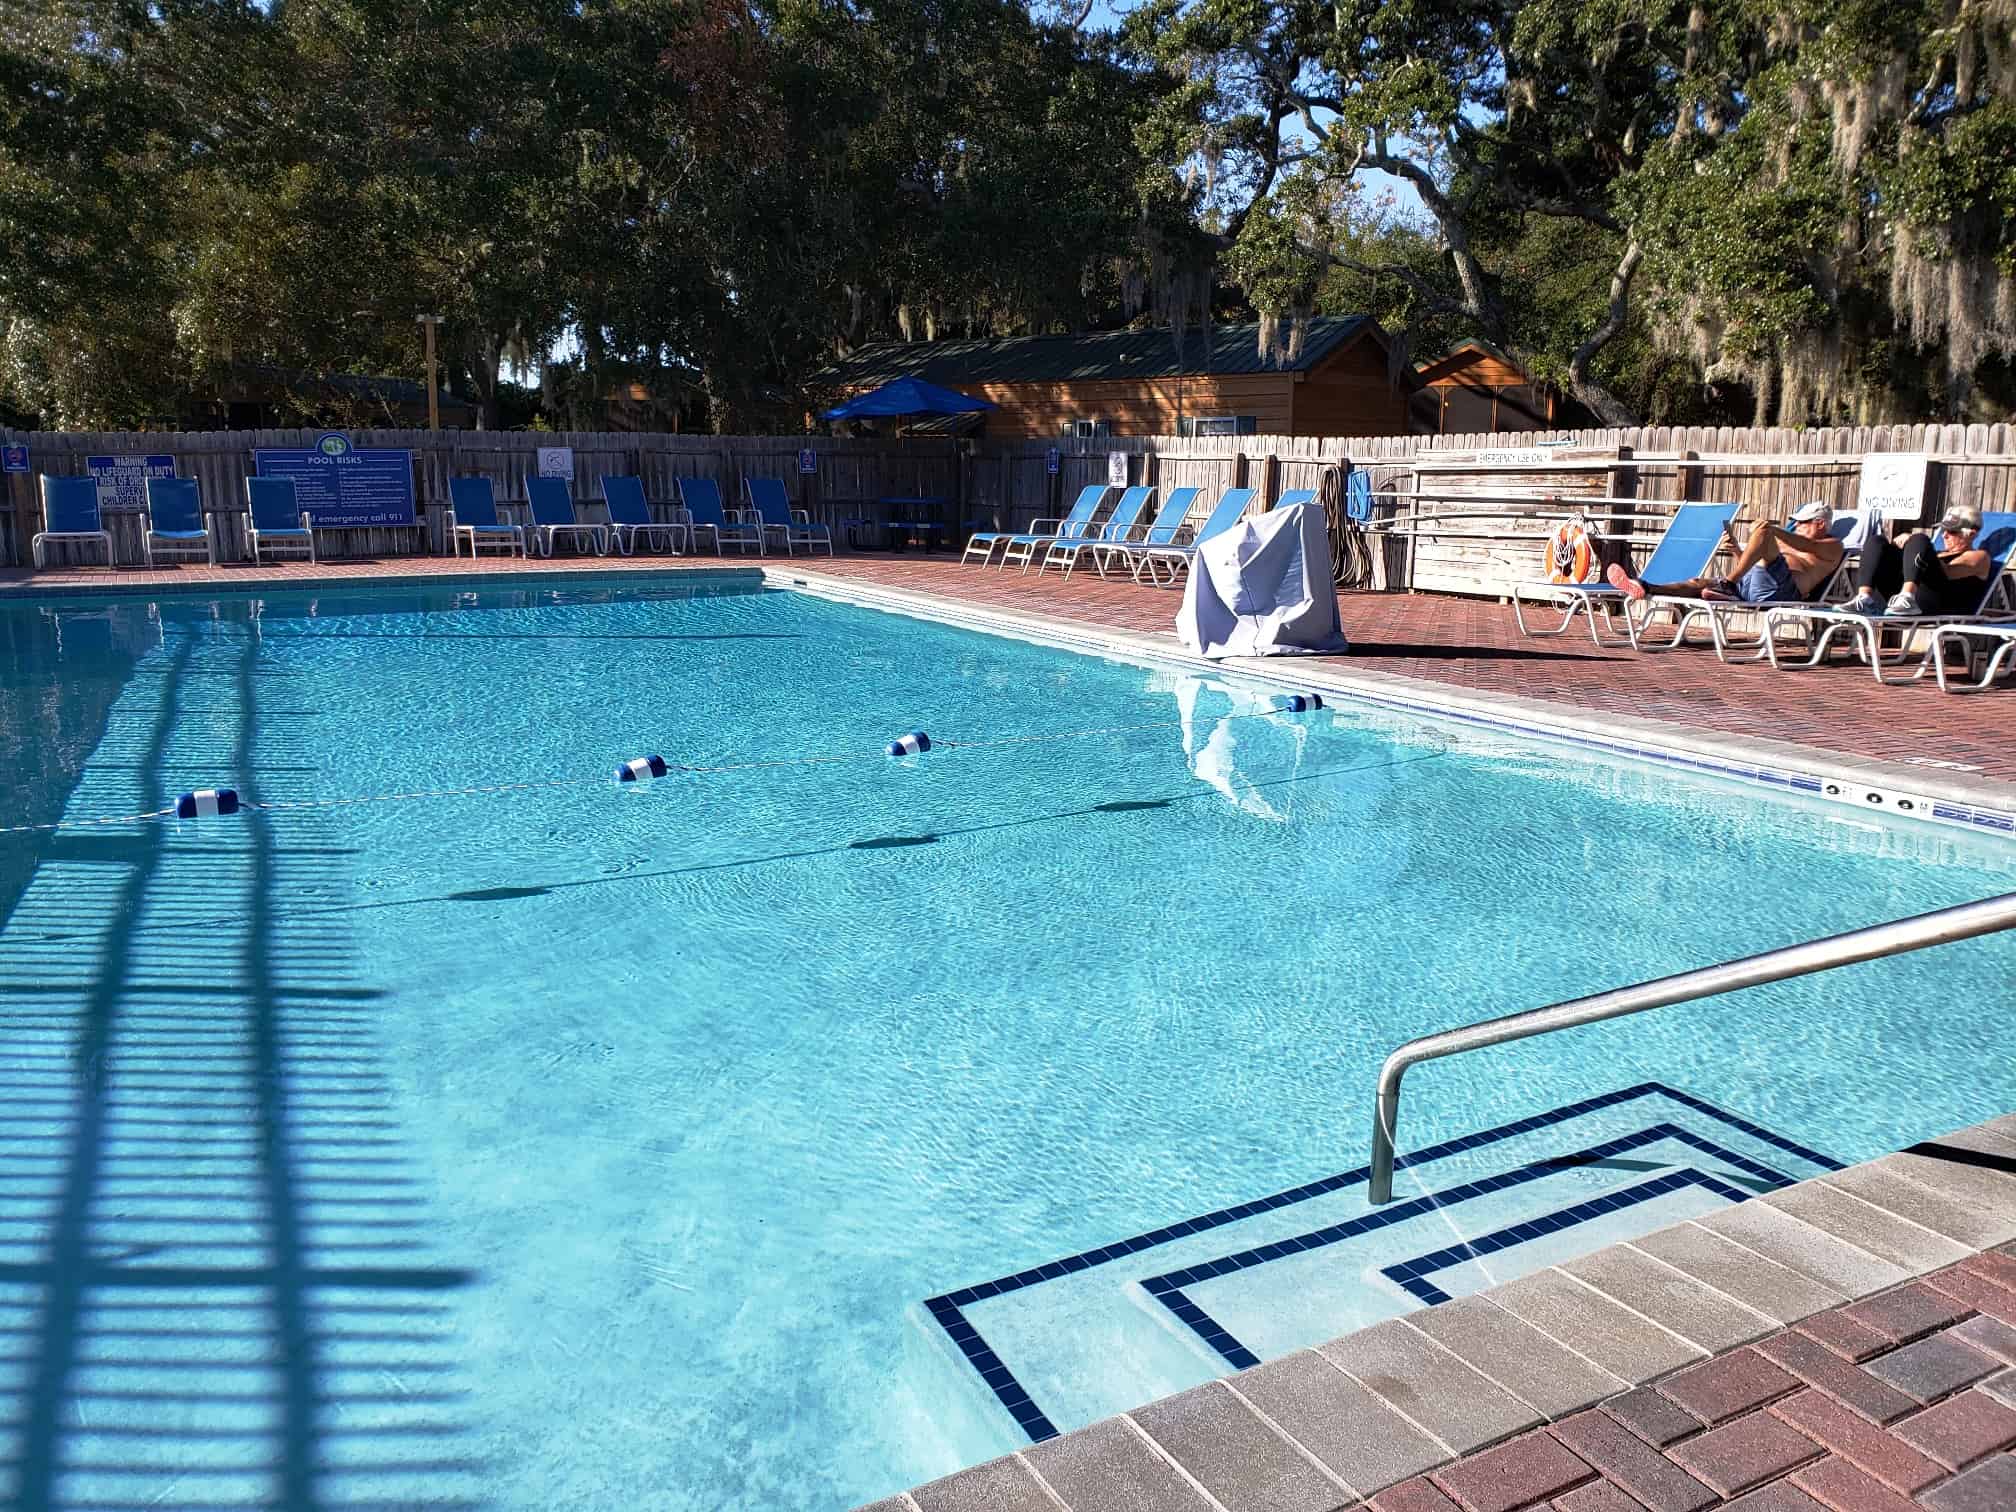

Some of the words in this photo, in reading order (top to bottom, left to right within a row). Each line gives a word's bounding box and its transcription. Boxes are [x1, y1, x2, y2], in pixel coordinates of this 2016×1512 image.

[113, 455, 147, 466] WARNING
[307, 456, 334, 465] POOL
[336, 455, 363, 465] RISKS
[89, 465, 100, 477] NO
[102, 465, 142, 477] LIFEGUARD
[143, 465, 154, 477] ON
[155, 464, 173, 476] DUTY
[102, 495, 137, 505] CHILDREN
[1865, 496, 1879, 508] NO
[1881, 496, 1915, 509] DIVING
[318, 513, 369, 523] emergency
[370, 510, 387, 521] call
[388, 512, 403, 521] 911
